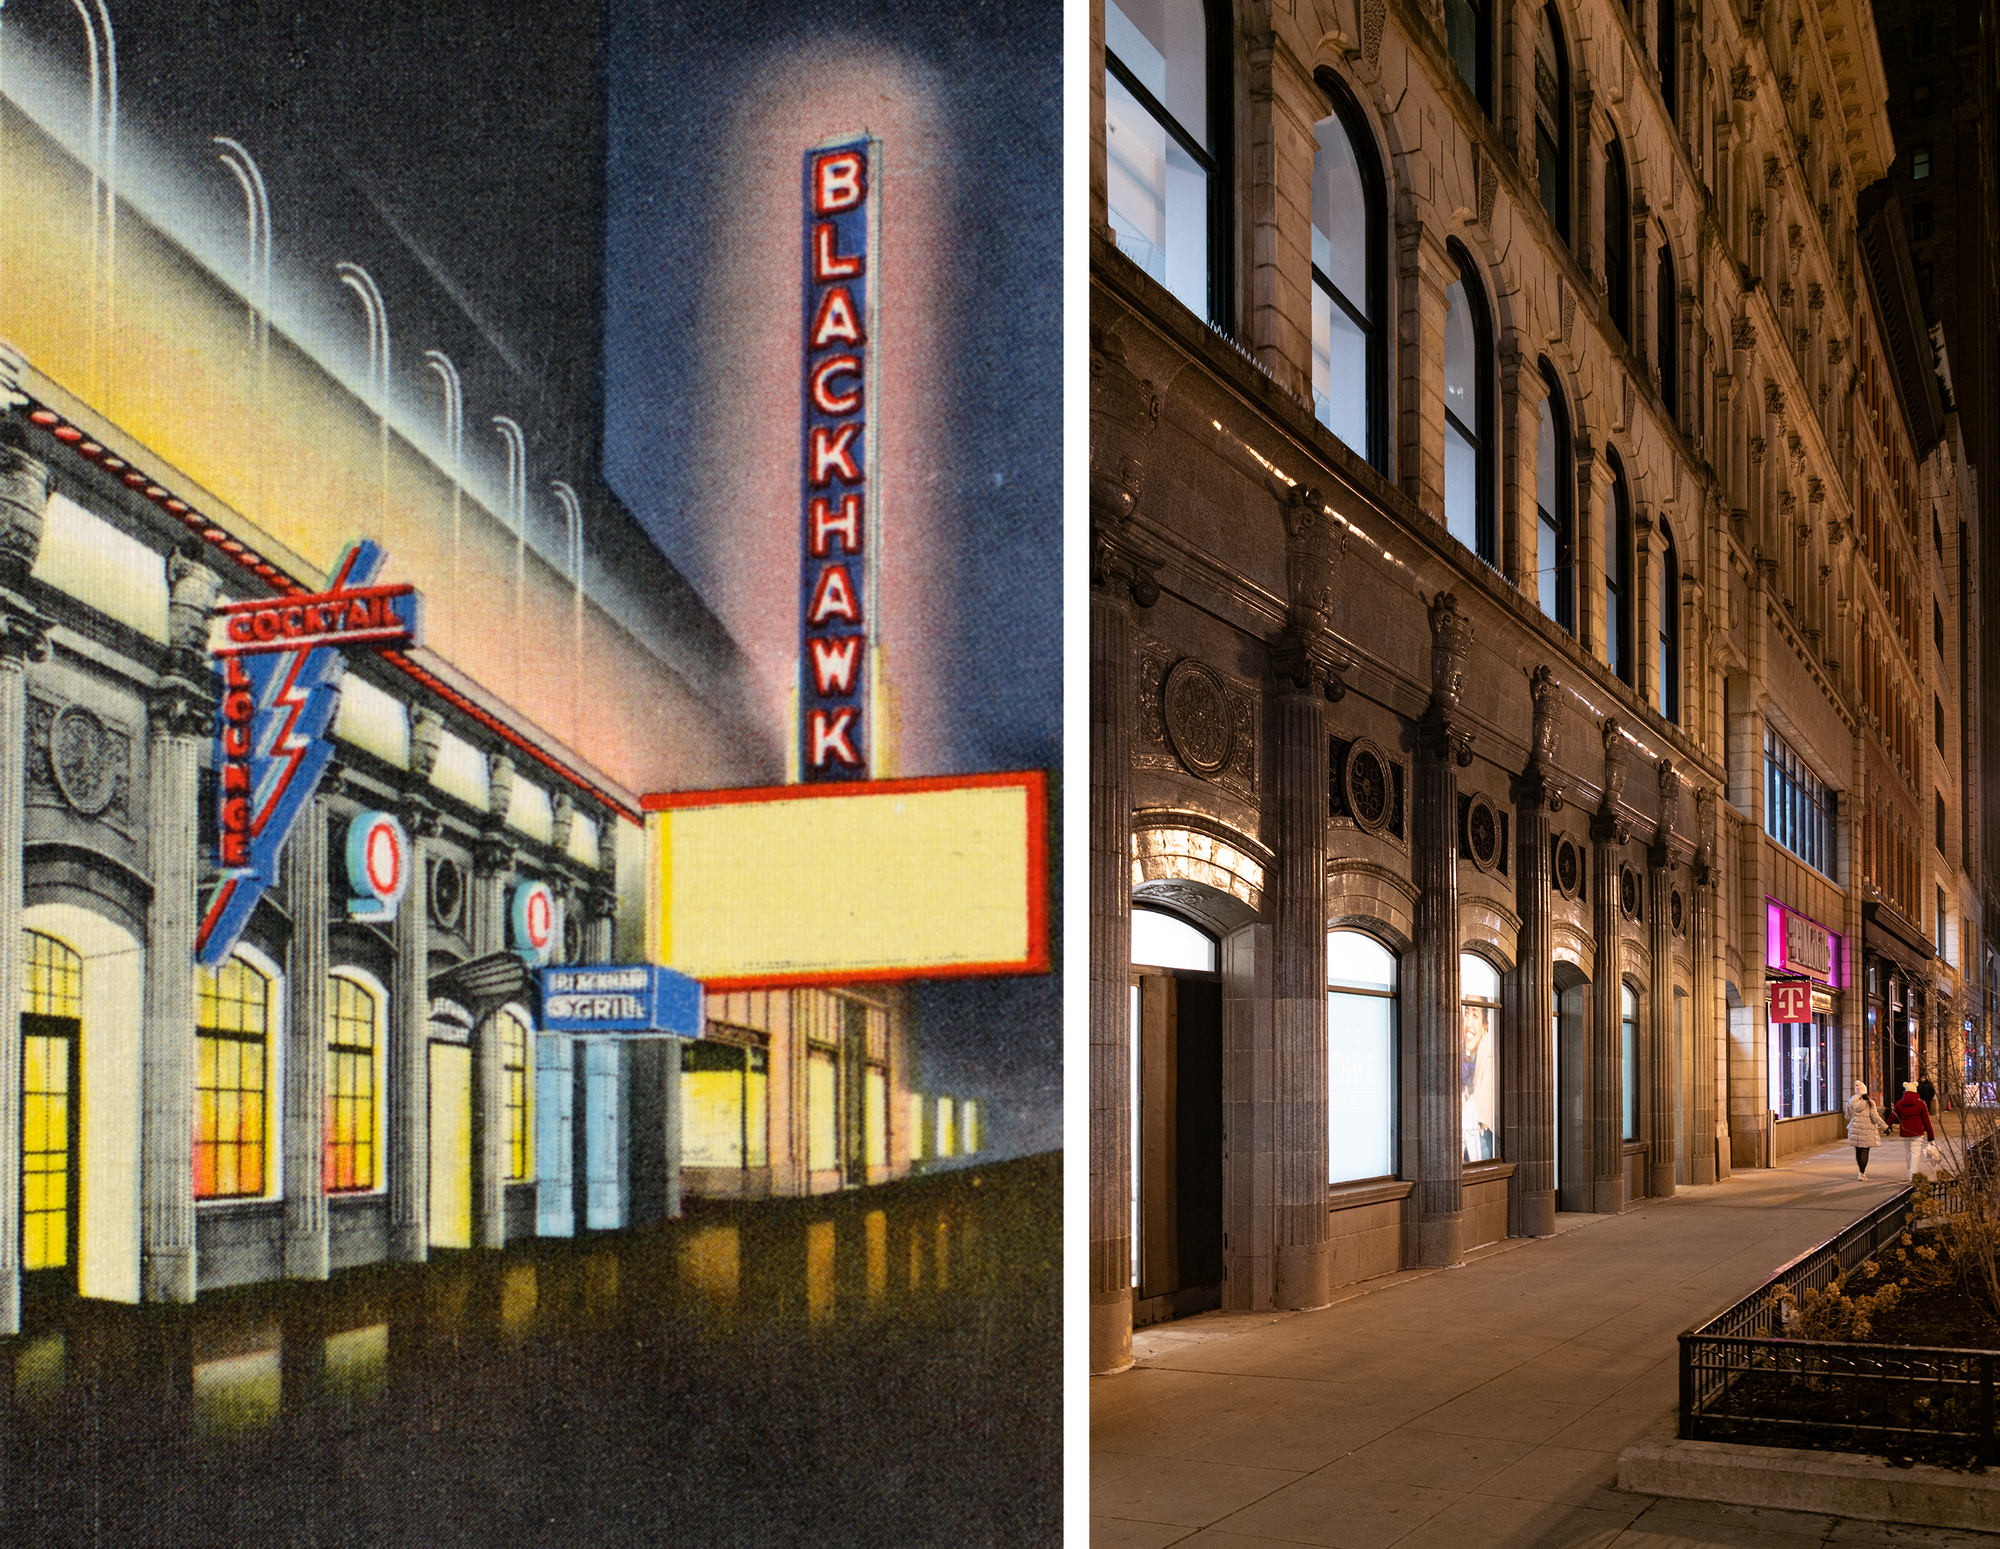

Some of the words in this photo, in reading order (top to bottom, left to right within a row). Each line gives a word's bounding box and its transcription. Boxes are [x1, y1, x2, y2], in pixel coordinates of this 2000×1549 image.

[808, 151, 866, 770] BLACKHAWK
[228, 597, 403, 643] COCKTAIL
[223, 656, 252, 868] LOUNGE
[1778, 987, 1804, 1019] T
[1329, 1053, 1375, 1085] OFT
[1331, 1095, 1360, 1106] OUTLET
